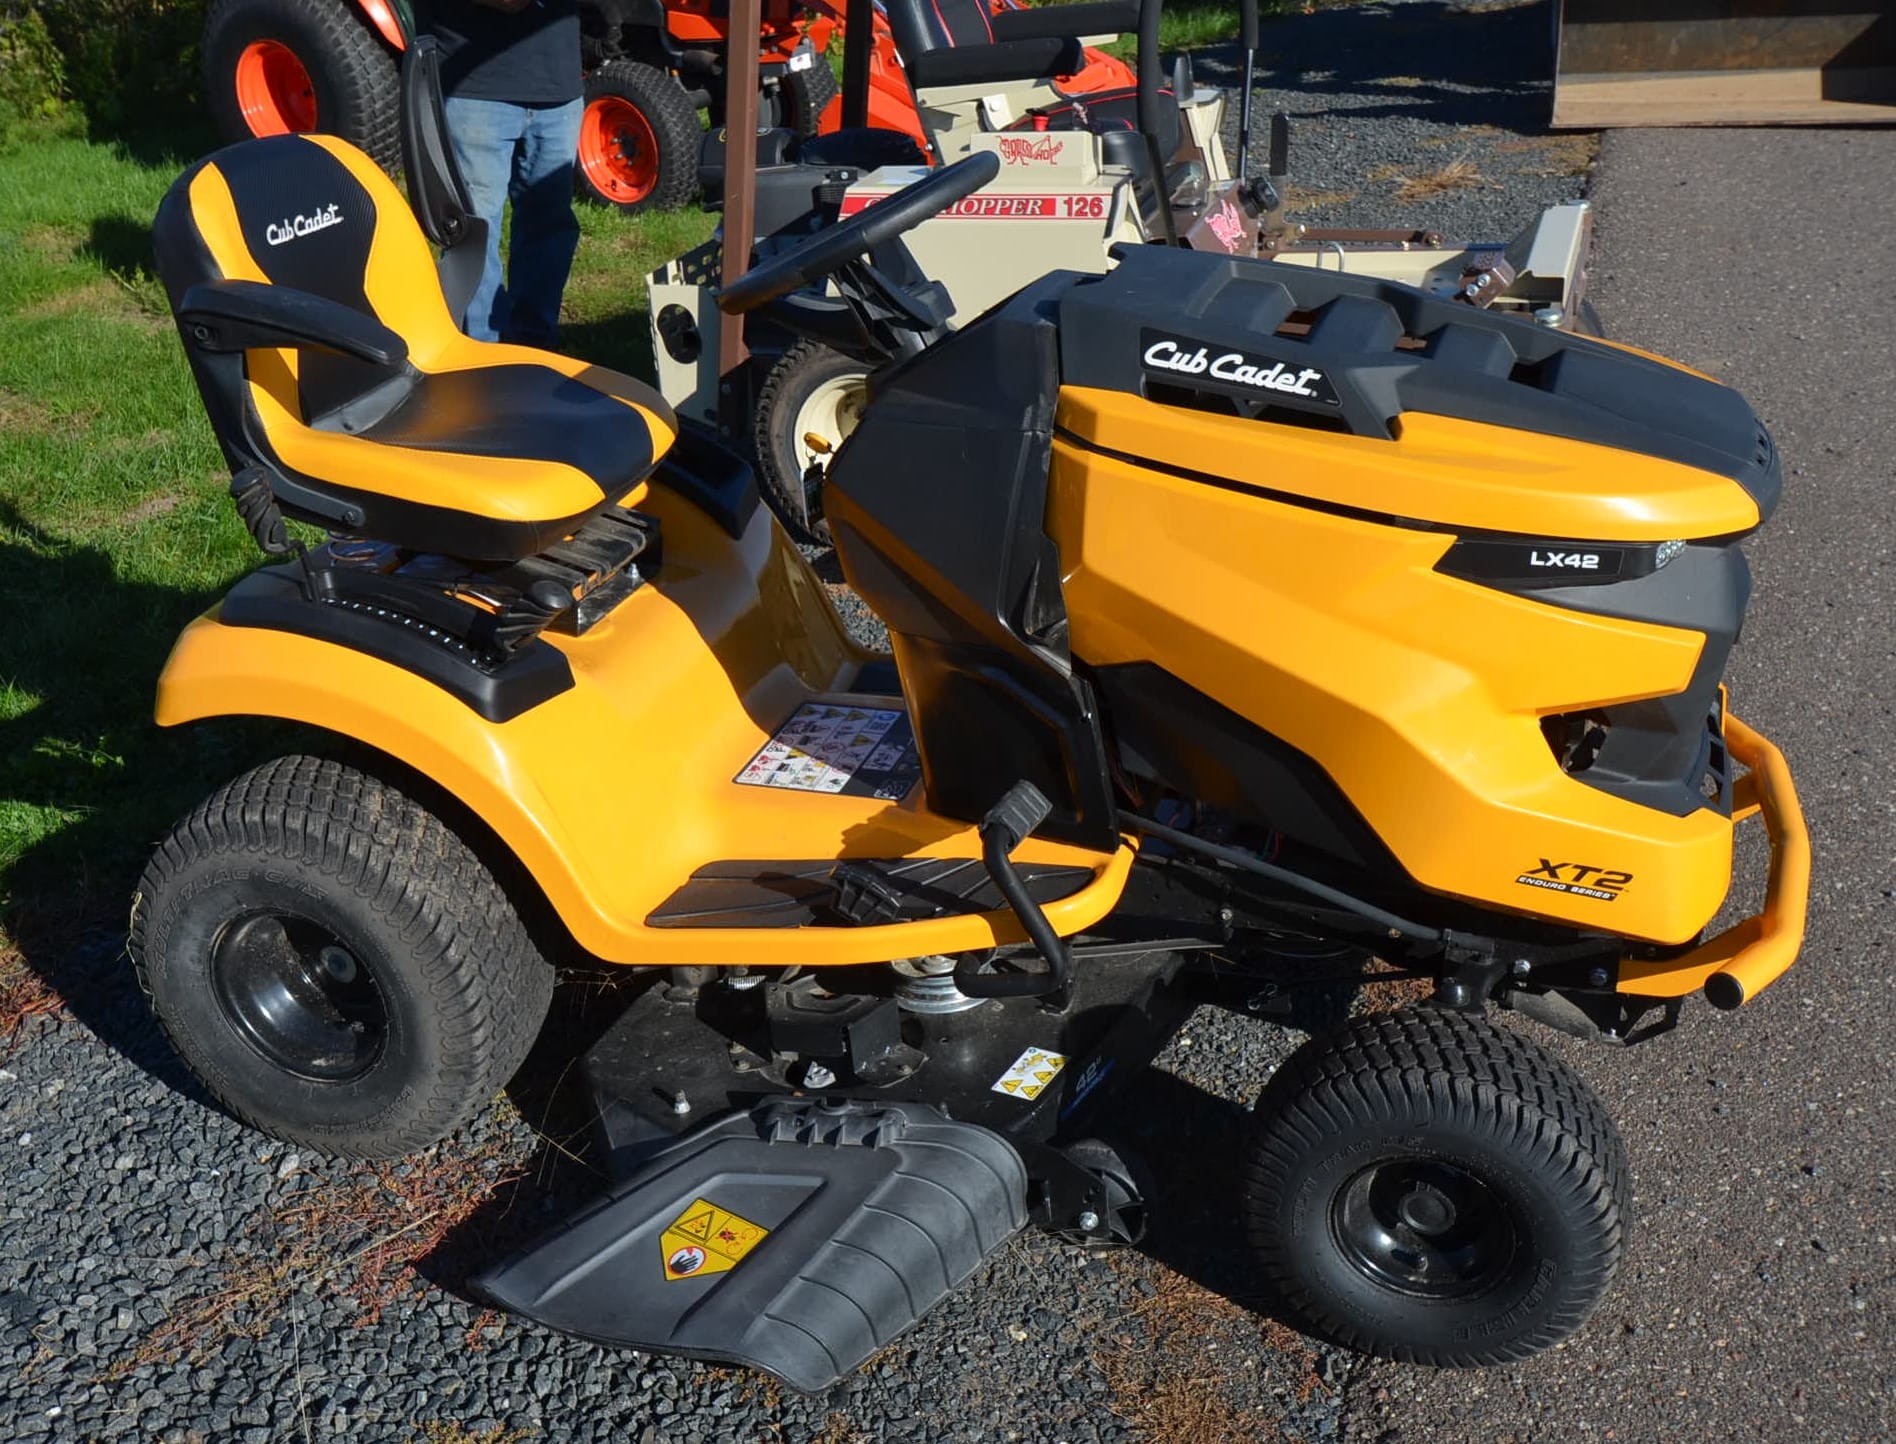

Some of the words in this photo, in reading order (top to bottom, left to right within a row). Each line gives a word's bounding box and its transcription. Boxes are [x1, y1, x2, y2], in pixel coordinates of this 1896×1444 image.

[1063, 197, 1104, 217] 126
[266, 218, 295, 246] Cub
[294, 203, 344, 237] Cadet
[1144, 341, 1208, 374] Cub
[1209, 354, 1321, 396] Cadet
[1530, 551, 1600, 569] LX42
[1518, 875, 1567, 891] ENDURO
[1570, 885, 1616, 900] SERIES
[1523, 857, 1634, 891] XT2
